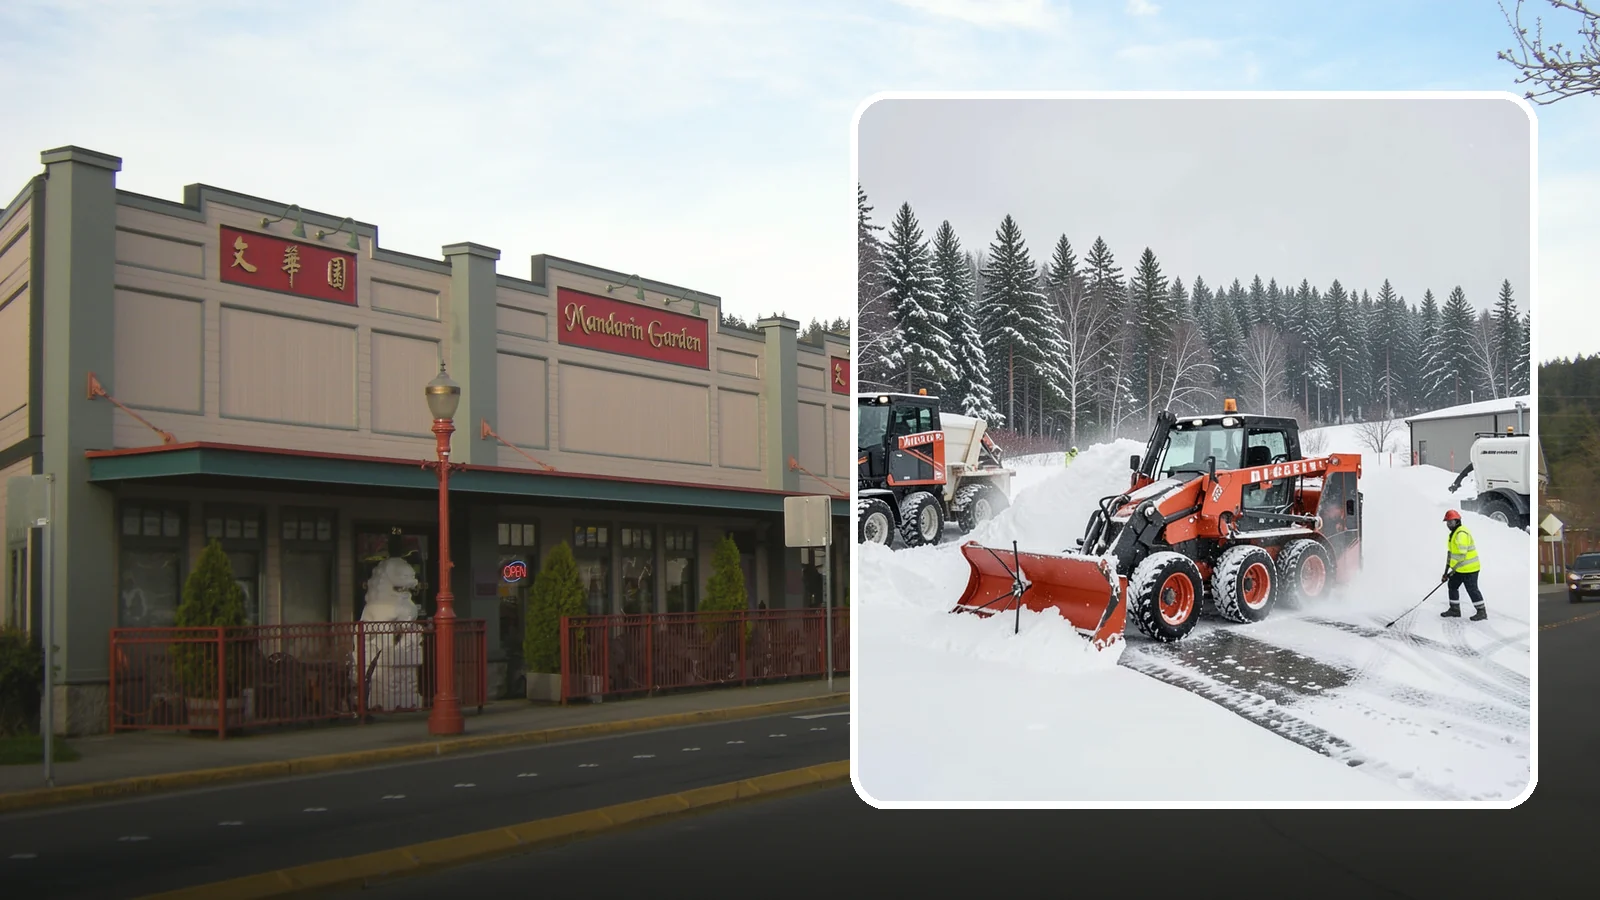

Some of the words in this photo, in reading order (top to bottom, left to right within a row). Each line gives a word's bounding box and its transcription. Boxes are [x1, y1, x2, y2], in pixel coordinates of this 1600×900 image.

[231, 235, 346, 290] 文華園
[564, 302, 644, 341] Mandarin
[647, 320, 701, 352] Garden
[503, 565, 527, 578] OPEN
